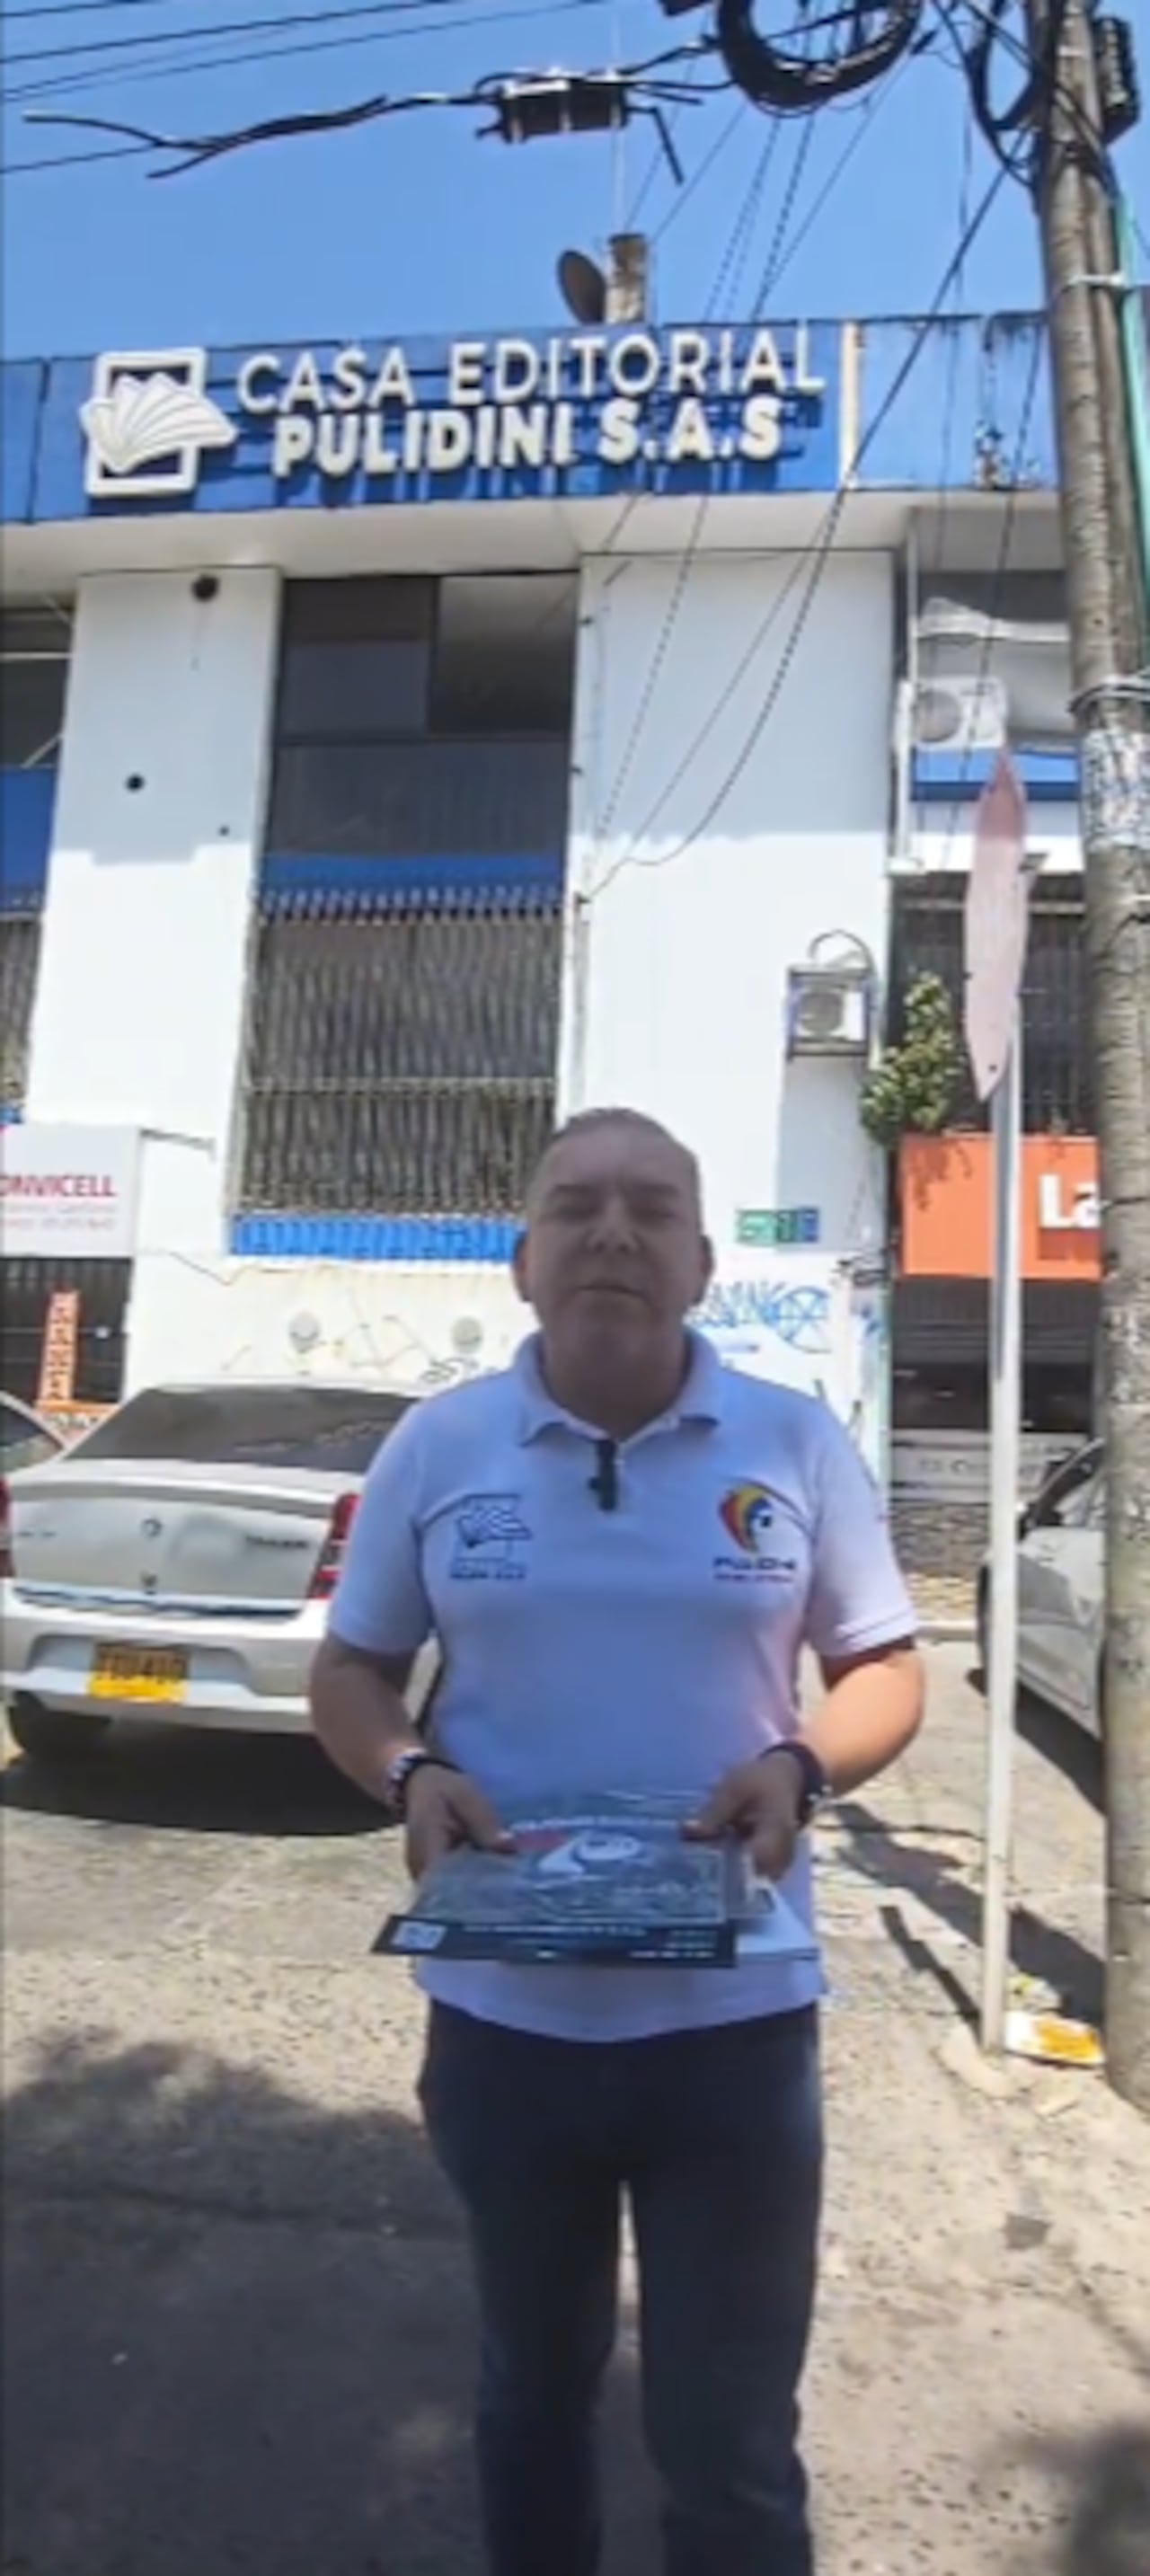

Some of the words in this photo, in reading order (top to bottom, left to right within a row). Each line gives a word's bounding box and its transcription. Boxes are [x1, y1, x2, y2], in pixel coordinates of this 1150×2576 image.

[237, 346, 415, 414] CASA
[451, 325, 827, 405] EDITORIAL
[273, 403, 573, 478] PULIDINI
[597, 395, 783, 464] S.A.S
